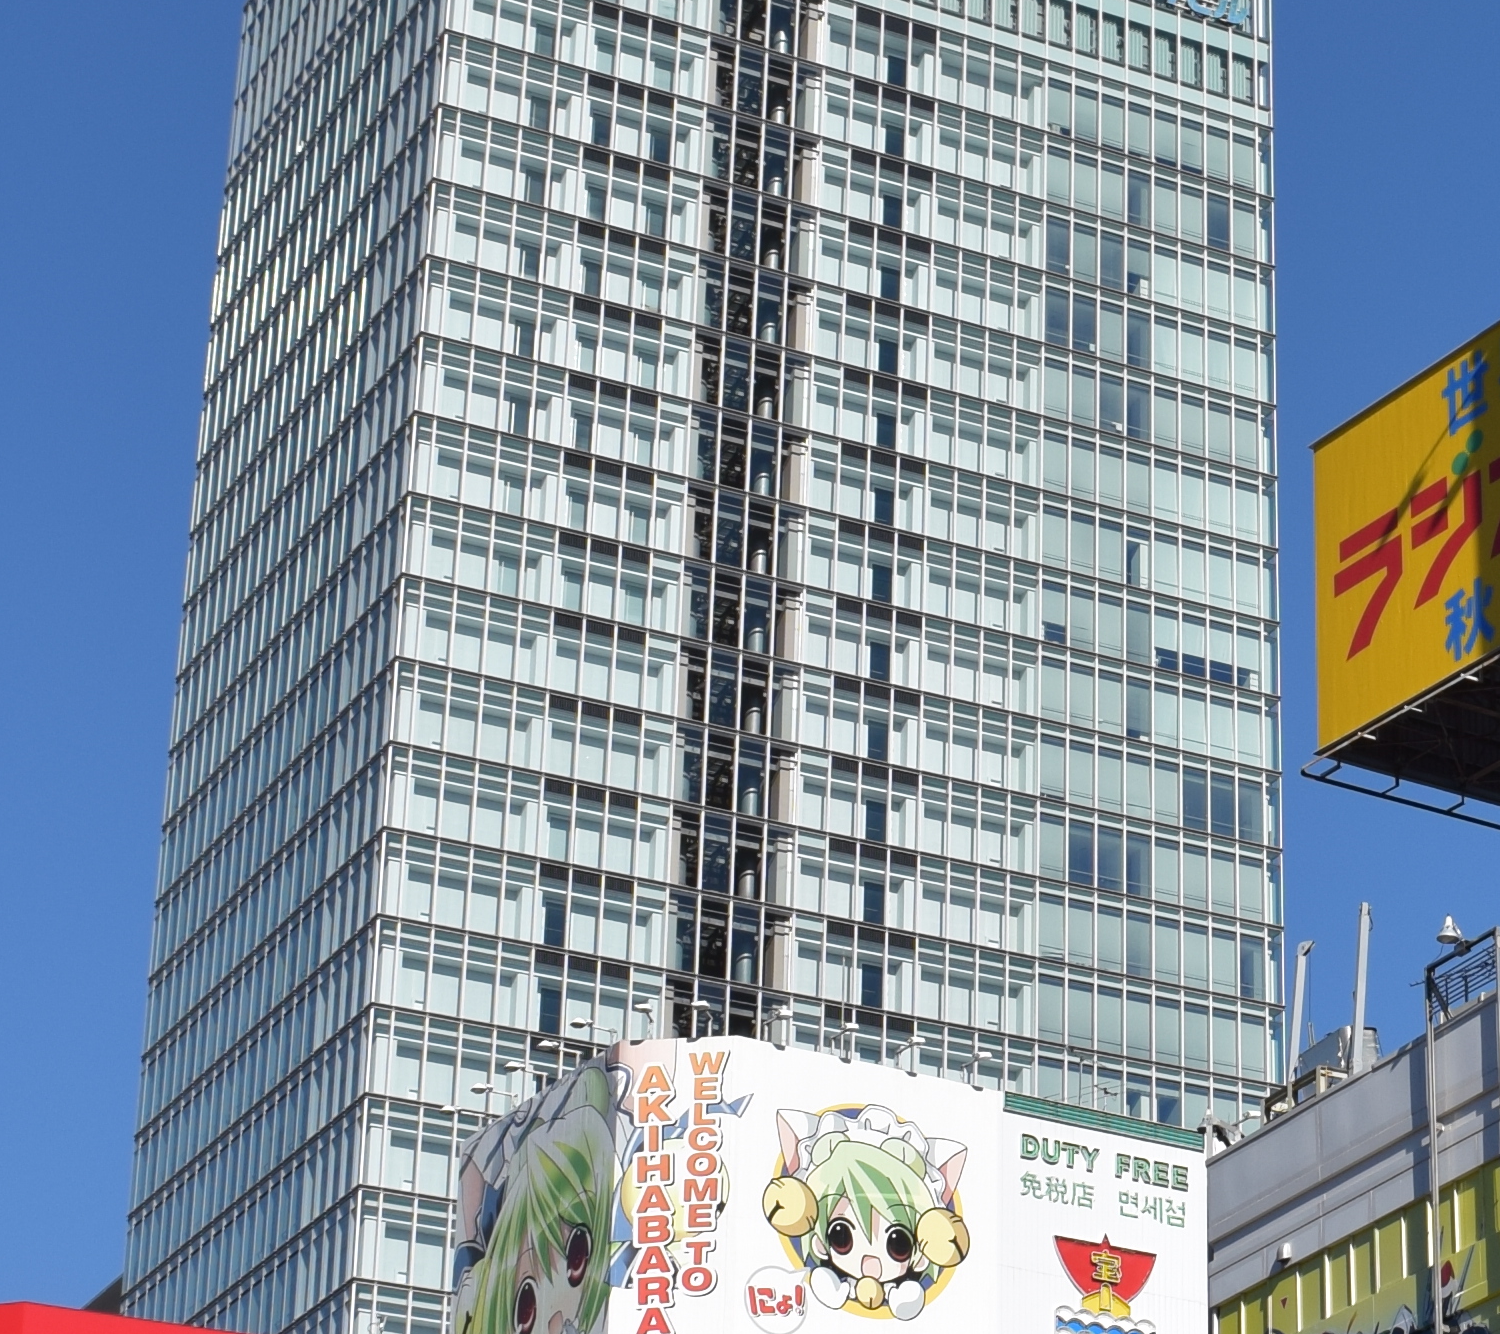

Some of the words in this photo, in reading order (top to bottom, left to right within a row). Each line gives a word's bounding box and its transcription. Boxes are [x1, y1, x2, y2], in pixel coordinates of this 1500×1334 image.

[681, 1049, 727, 1234] WELCOME
[1019, 1132, 1100, 1174] DUTY
[1114, 1152, 1190, 1194] FREE
[1016, 1169, 1096, 1211] 免税店
[1118, 1189, 1188, 1230] 면세점
[680, 1240, 713, 1297] TO
[746, 1285, 805, 1321] にょ!
